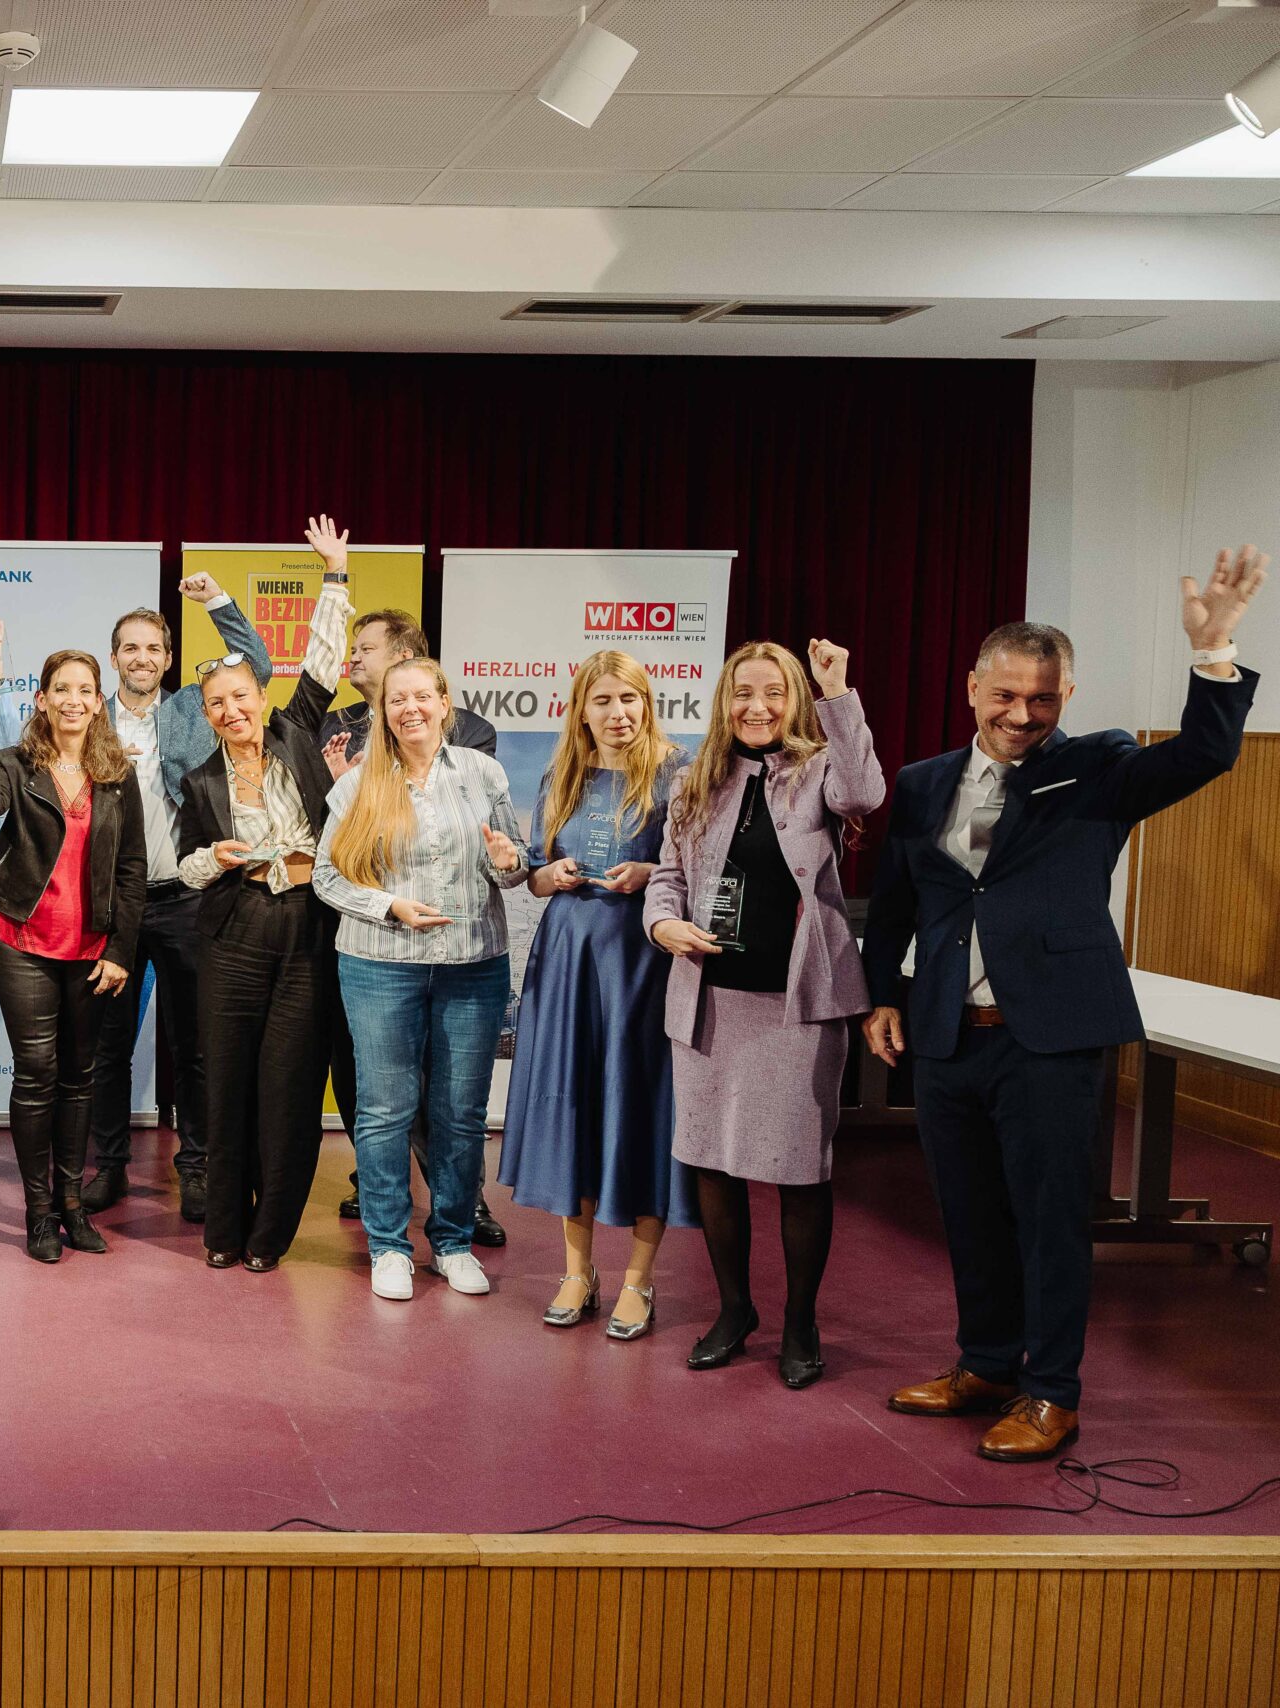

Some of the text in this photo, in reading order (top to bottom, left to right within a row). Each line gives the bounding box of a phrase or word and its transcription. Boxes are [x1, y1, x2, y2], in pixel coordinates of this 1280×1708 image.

[257, 580, 304, 595] WIENER
[255, 597, 317, 622] BEZIR
[585, 602, 675, 631] WKO
[680, 613, 704, 622] WIEN
[257, 624, 311, 658] BLA
[584, 634, 680, 642] WIRTSCHAFTSKAMMER
[463, 661, 556, 677] HERZLICH
[462, 690, 538, 718] WKO
